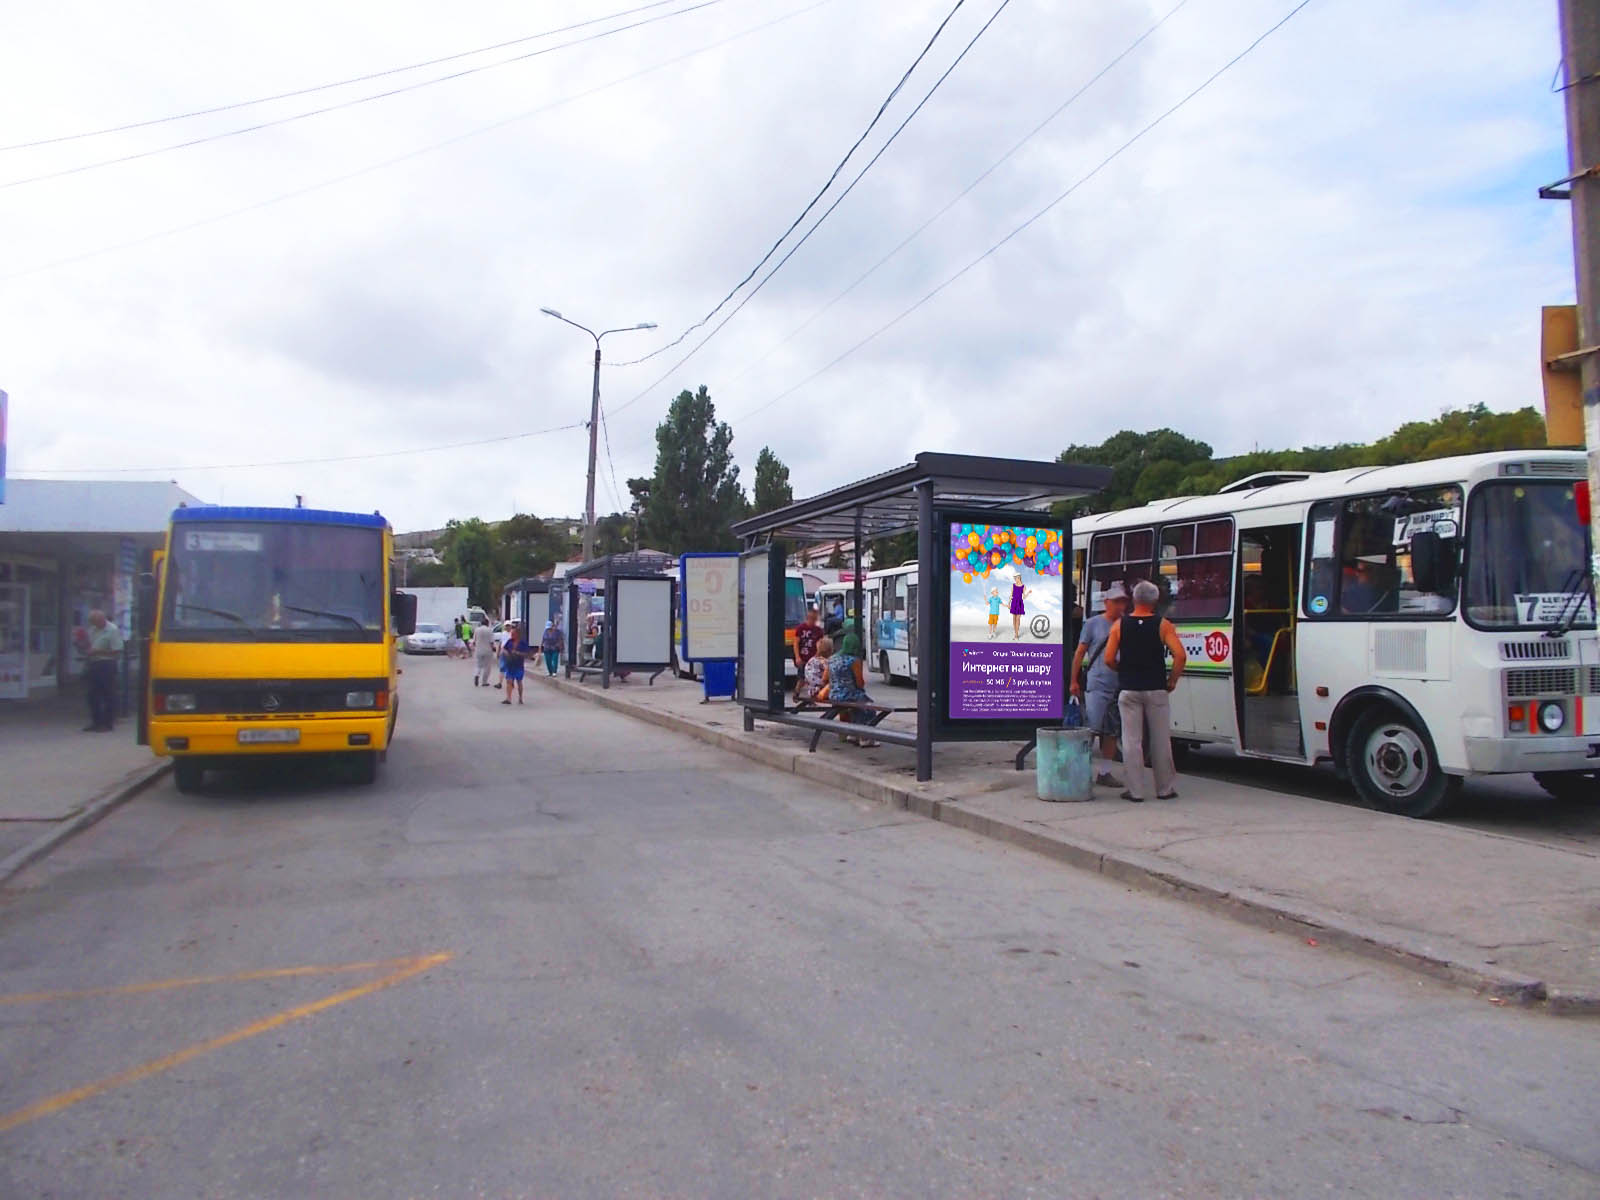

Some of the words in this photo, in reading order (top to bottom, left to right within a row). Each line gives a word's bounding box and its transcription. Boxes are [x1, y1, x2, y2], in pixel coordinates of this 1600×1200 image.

[1397, 518, 1408, 541] 7
[189, 534, 200, 550] 3
[1519, 597, 1539, 621] 7
[962, 661, 1010, 675] Интернет
[1011, 664, 1024, 673] на
[1026, 665, 1051, 675] шару
